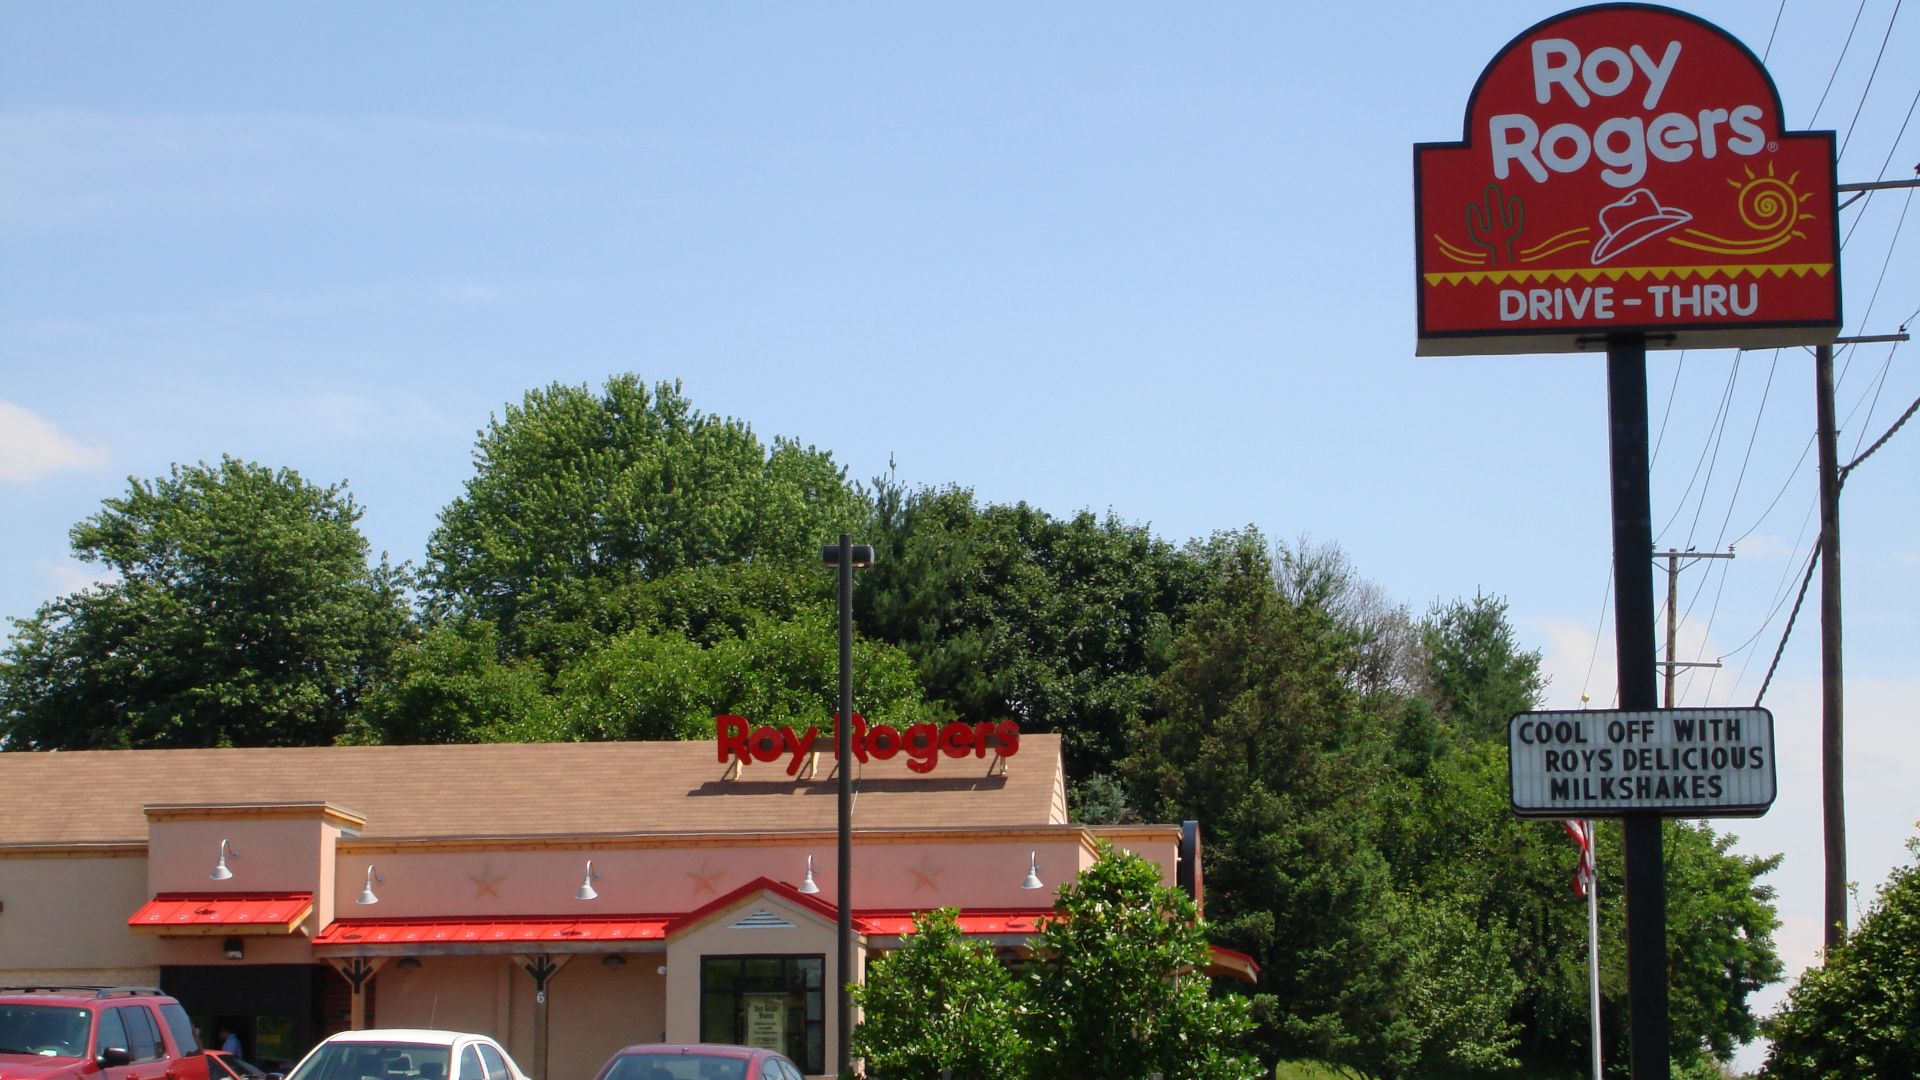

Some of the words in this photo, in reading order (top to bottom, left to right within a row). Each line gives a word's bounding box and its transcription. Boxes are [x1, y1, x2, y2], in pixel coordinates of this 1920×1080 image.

[1531, 38, 1682, 110] Roy
[1489, 105, 1766, 188] Rogers
[716, 714, 819, 776] Roy
[834, 712, 1020, 774] Rogers
[1519, 721, 1588, 744] COOL
[1607, 720, 1655, 743] OFF
[1674, 719, 1741, 742] WITH
[1545, 749, 1613, 772] ROYS
[1623, 746, 1764, 771] DELICIOUS
[1550, 775, 1723, 800] MILKSHAKES
[536, 991, 545, 1004] 6
